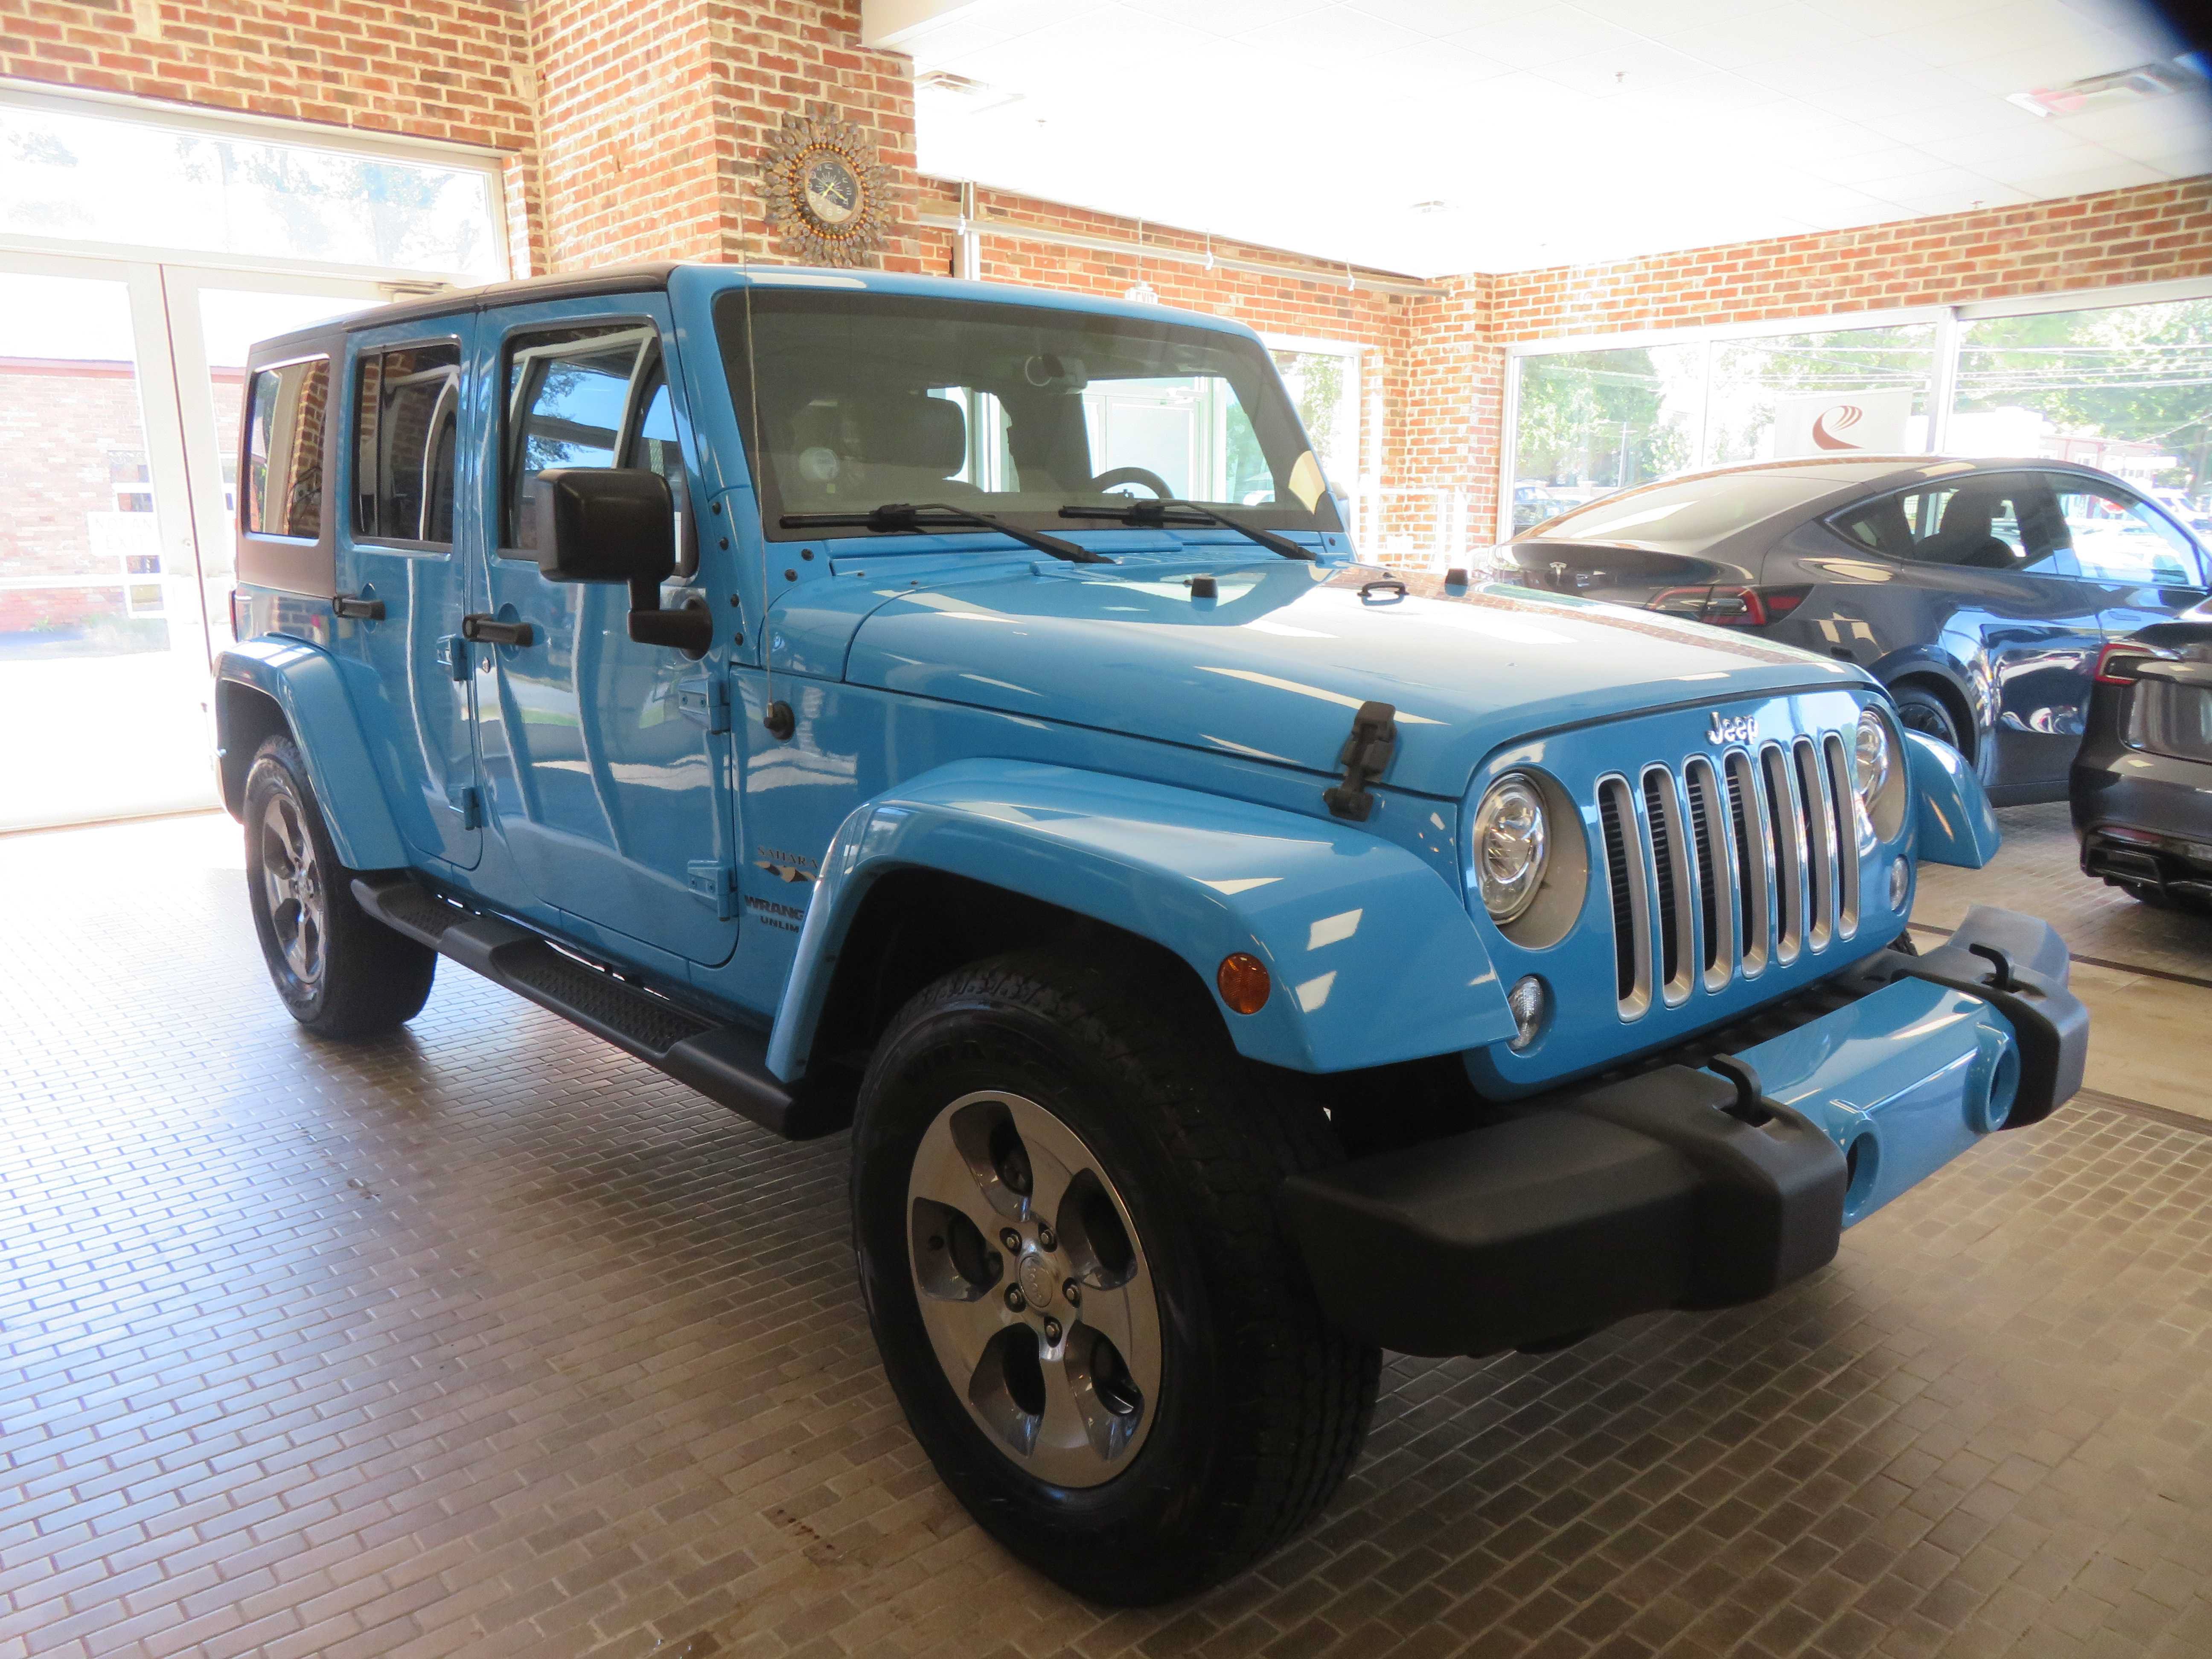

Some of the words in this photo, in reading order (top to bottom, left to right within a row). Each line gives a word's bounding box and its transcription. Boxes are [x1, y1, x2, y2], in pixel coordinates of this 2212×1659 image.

[809, 192, 817, 202] 8
[827, 208, 833, 216] 6
[836, 205, 843, 214] 5
[95, 517, 125, 530] NOT
[133, 518, 152, 530] AN
[106, 534, 143, 550] EXIT
[1706, 711, 1759, 745] Jeep
[758, 846, 818, 868] SAHARA
[760, 915, 800, 933] UNLIM
